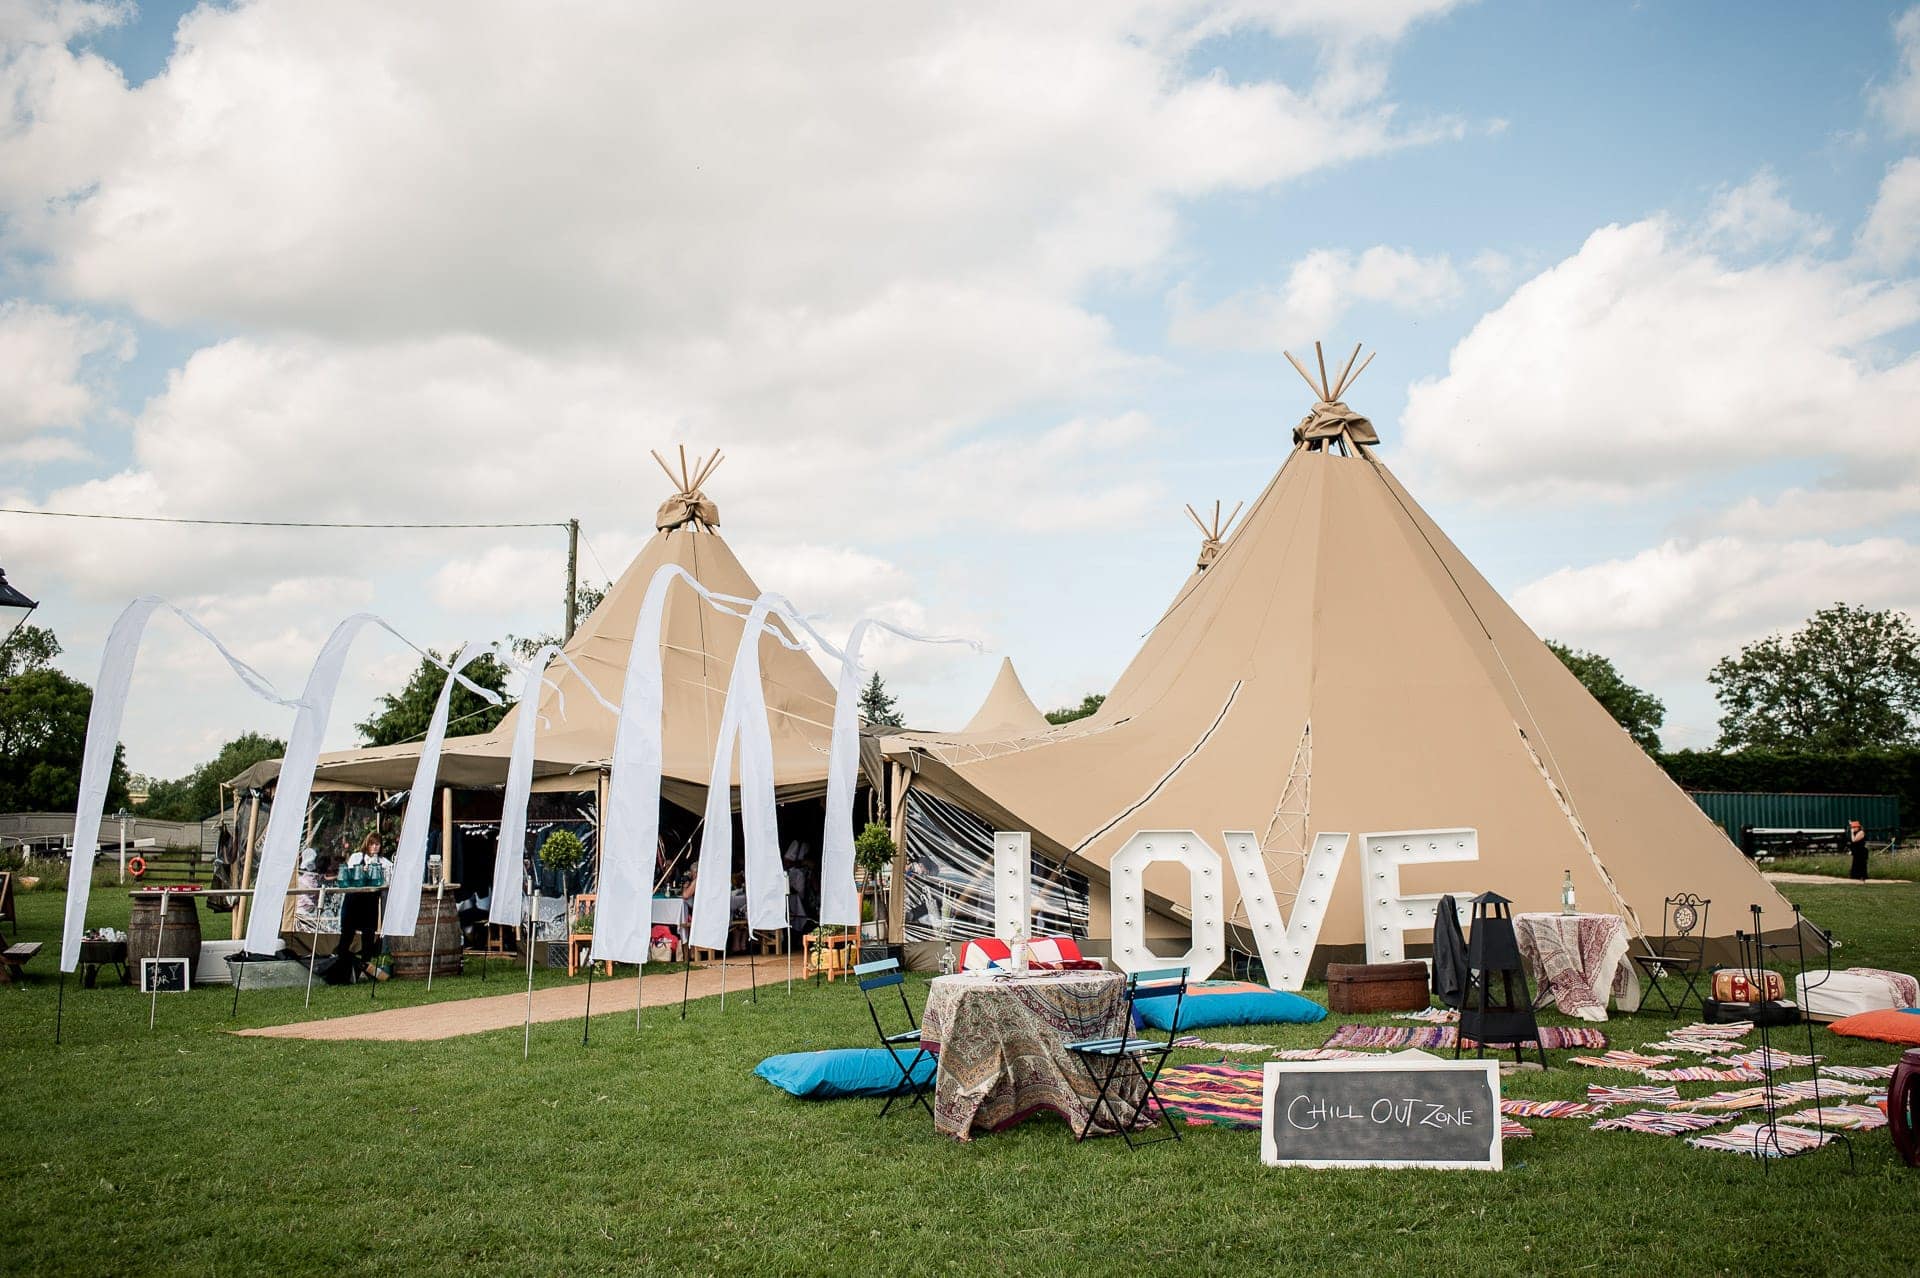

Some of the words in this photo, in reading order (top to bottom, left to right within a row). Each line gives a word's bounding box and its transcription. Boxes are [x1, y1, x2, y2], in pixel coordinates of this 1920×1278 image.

[1287, 1095, 1364, 1130] CHILL
[1371, 1098, 1423, 1127] OUT
[1420, 1103, 1474, 1129] ZONE
